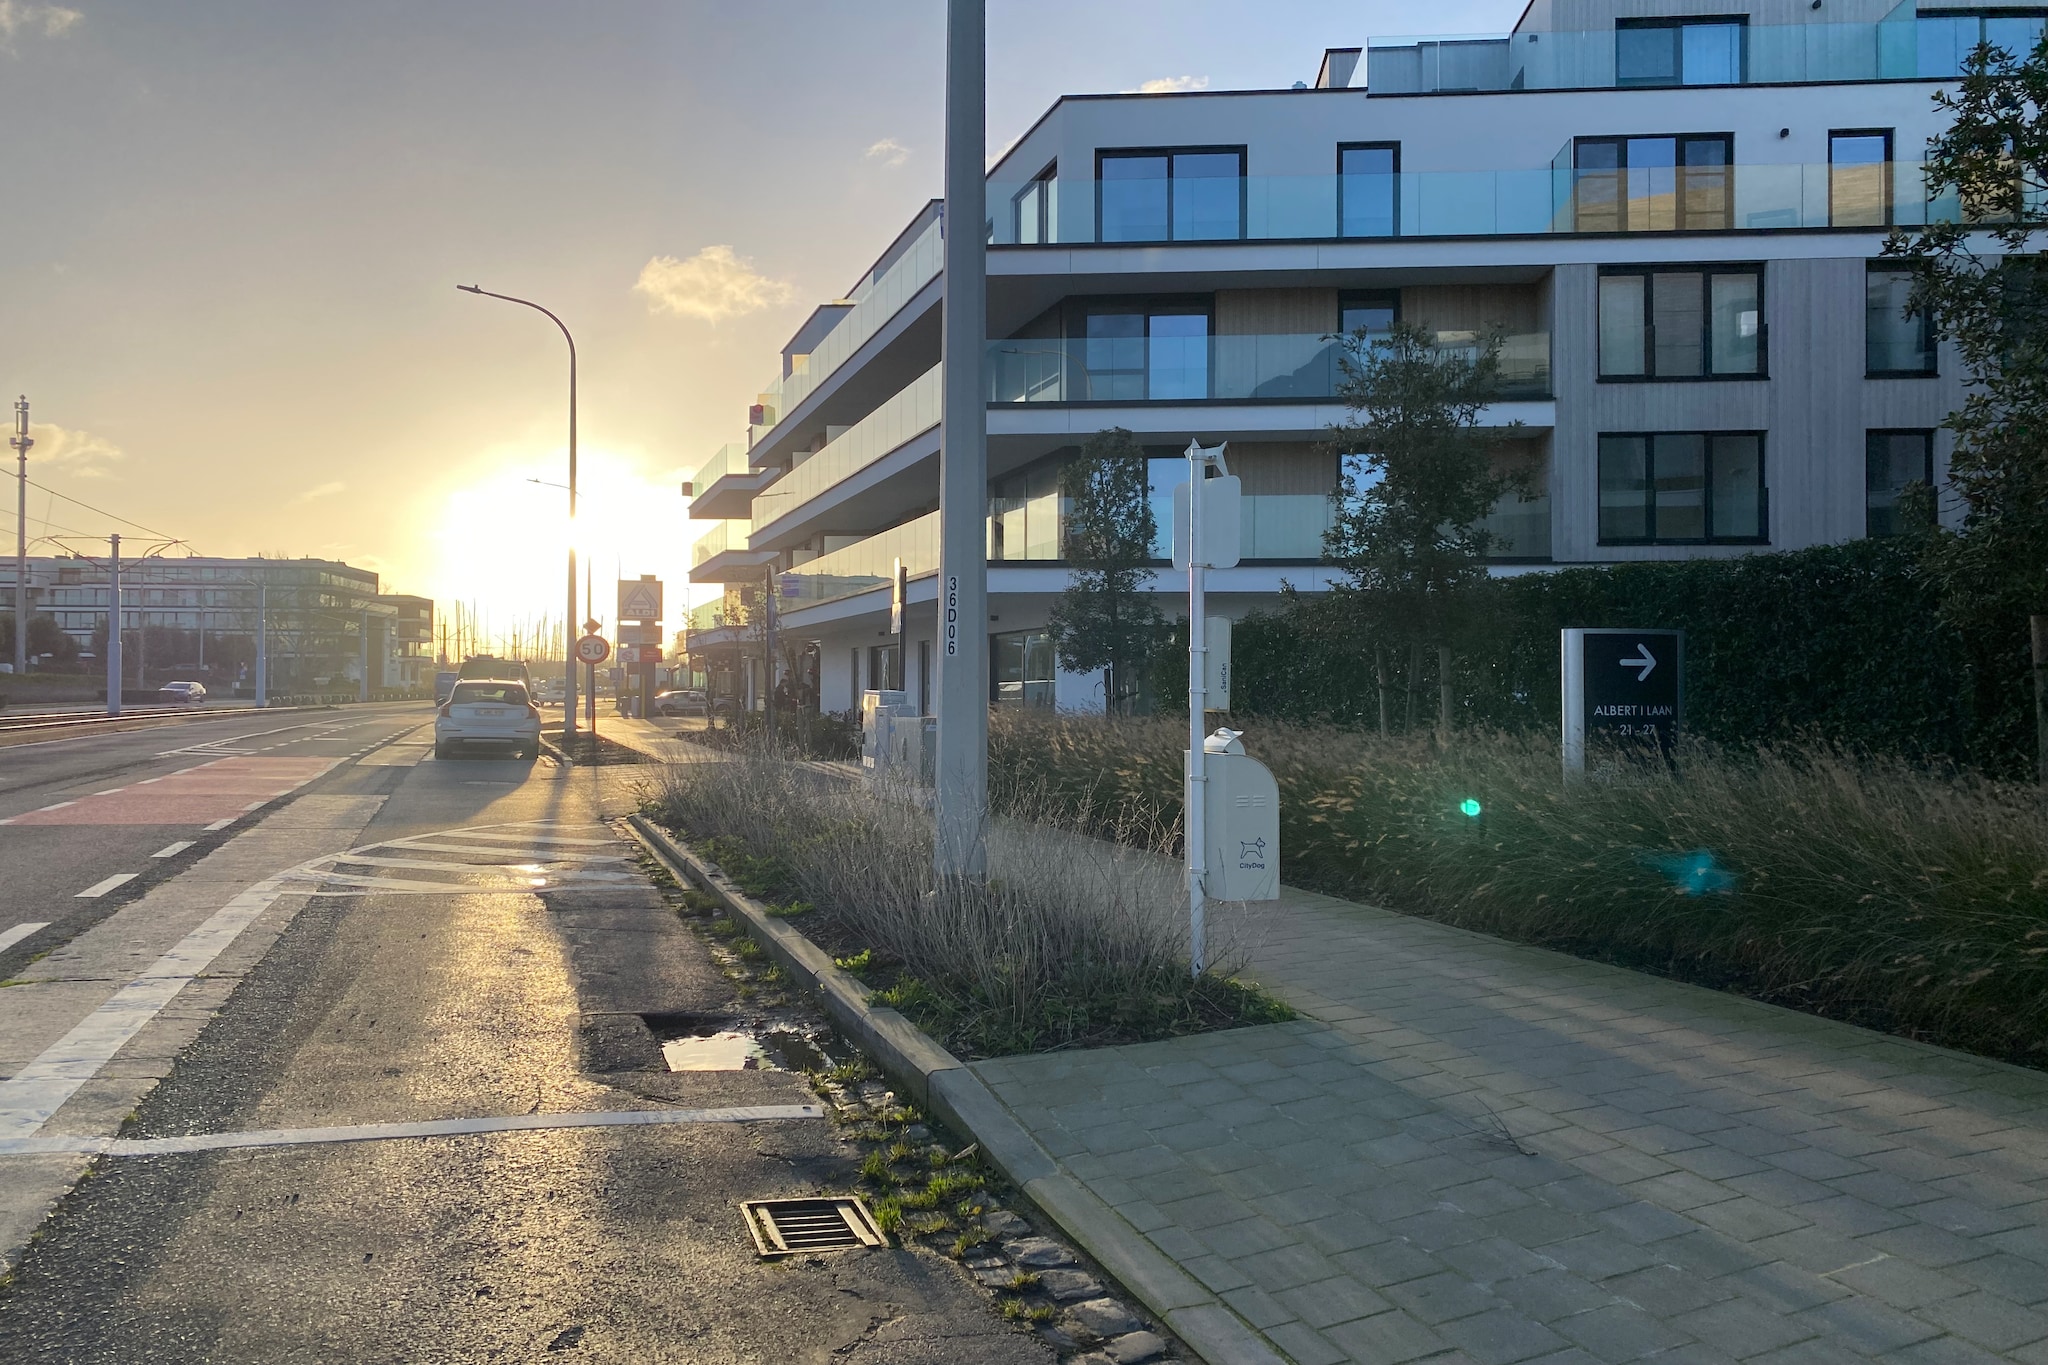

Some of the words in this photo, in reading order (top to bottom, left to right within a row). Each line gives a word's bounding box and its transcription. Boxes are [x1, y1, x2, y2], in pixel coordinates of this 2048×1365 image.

[625, 609, 655, 617] ALDI
[948, 576, 957, 655] 36D06
[582, 643, 603, 655] 50
[1594, 705, 1637, 716] ALBERT
[1647, 705, 1672, 716] LAAN
[1619, 724, 1632, 736] 21
[1643, 724, 1656, 735] 27
[1239, 862, 1265, 870] CityDog
